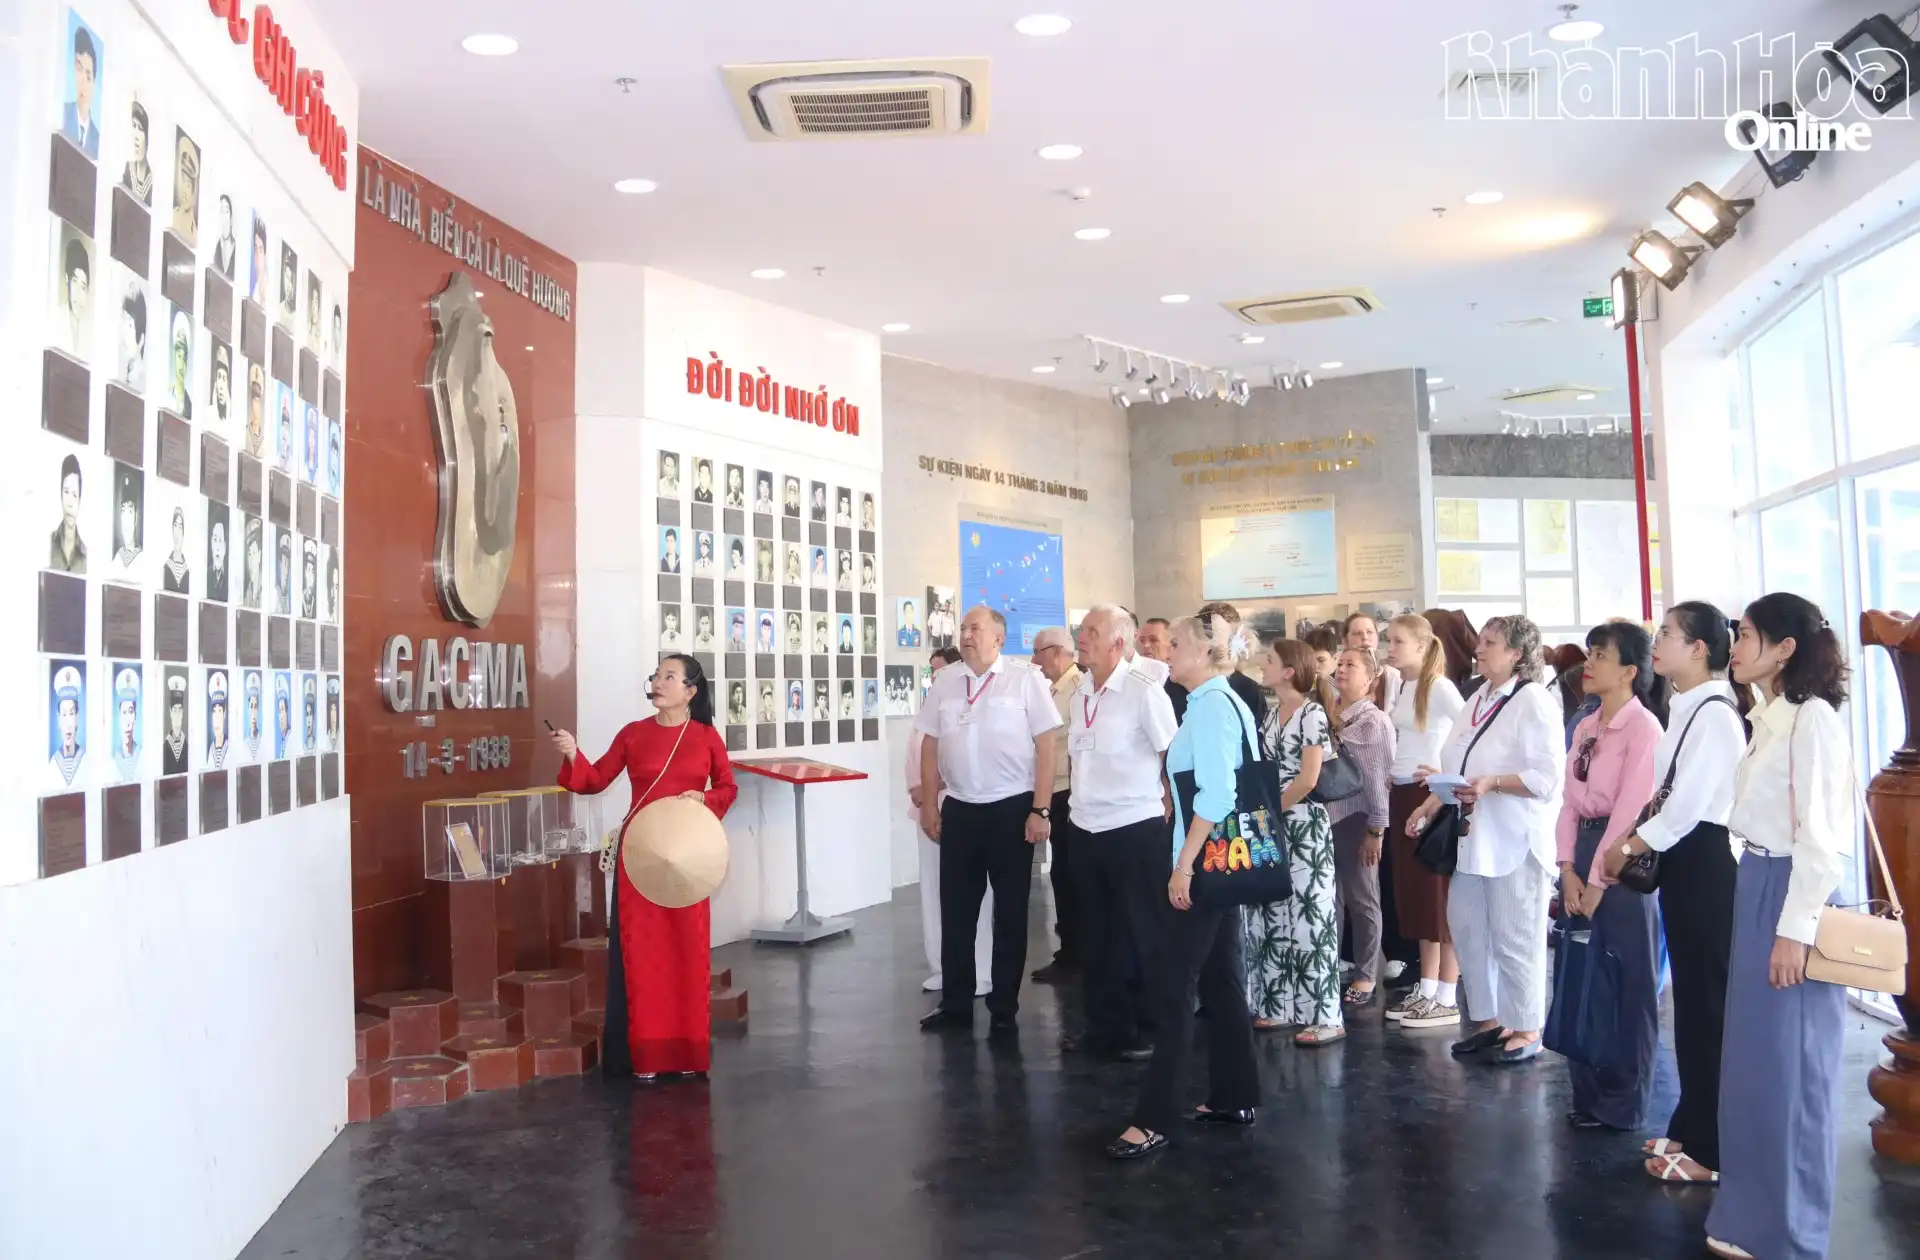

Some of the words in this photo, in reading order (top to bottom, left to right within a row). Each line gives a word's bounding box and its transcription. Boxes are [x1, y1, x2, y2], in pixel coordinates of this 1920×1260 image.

[253, 4, 297, 117] GHI
[363, 159, 386, 214] LÀ
[485, 238, 502, 283] LÀ
[505, 254, 529, 298] QUÊ
[686, 350, 732, 403] ĐỜI
[738, 366, 780, 415] ĐỜI
[784, 384, 828, 427] NHỚ
[832, 396, 860, 436] ƠN
[994, 470, 1005, 486] 14
[382, 634, 470, 727] GẠC
[471, 641, 529, 709] MA
[1203, 835, 1282, 873] NAM
